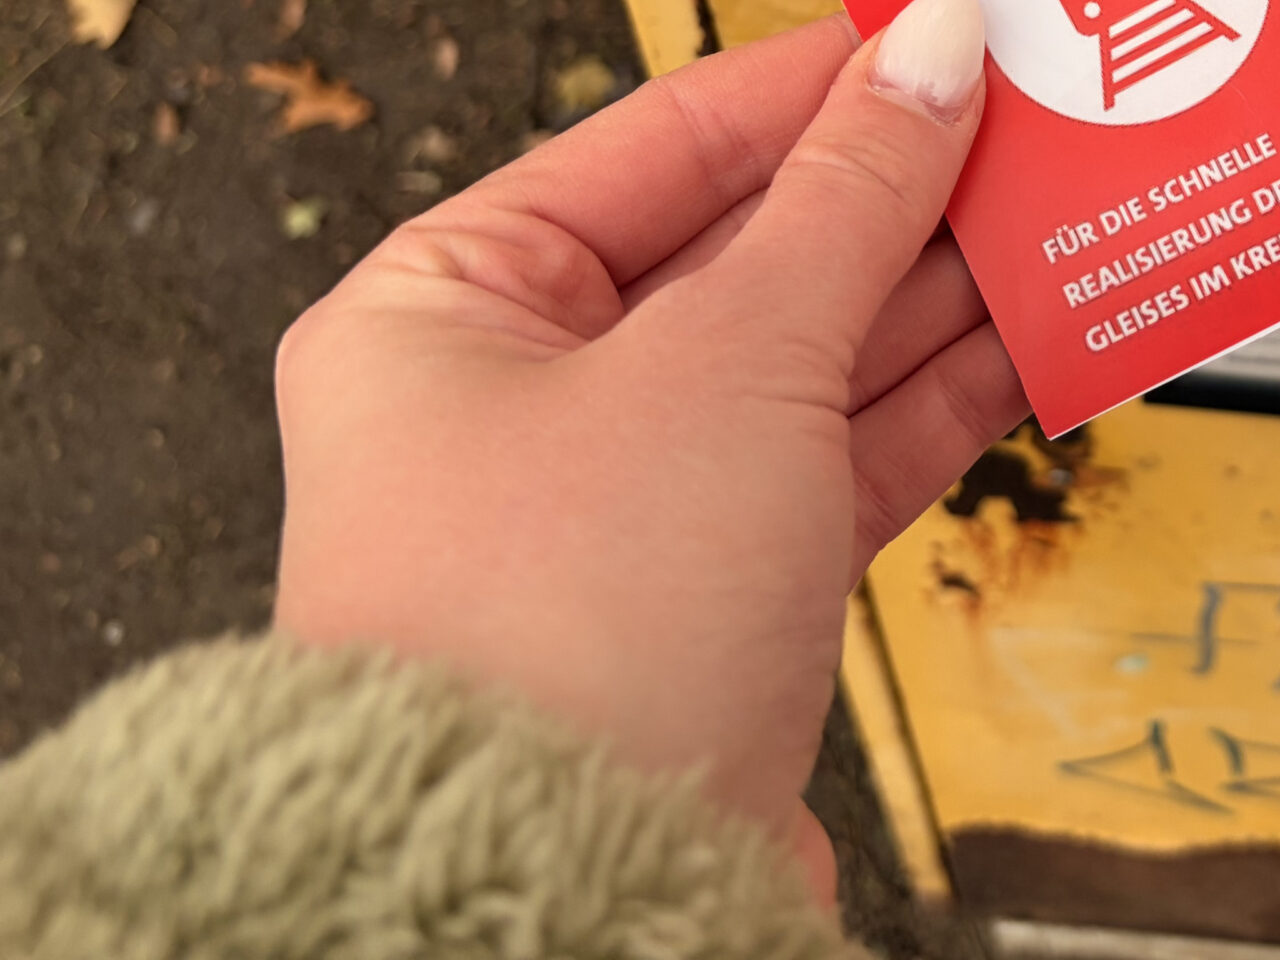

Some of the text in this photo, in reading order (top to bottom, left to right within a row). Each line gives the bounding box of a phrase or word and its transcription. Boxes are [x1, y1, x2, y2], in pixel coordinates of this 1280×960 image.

[1042, 133, 1277, 265] FÜR DIE SCHNELLE
[1062, 198, 1253, 308] REALISIERUNG
[1086, 285, 1189, 351] GLEISES
[1190, 264, 1231, 299] IM
